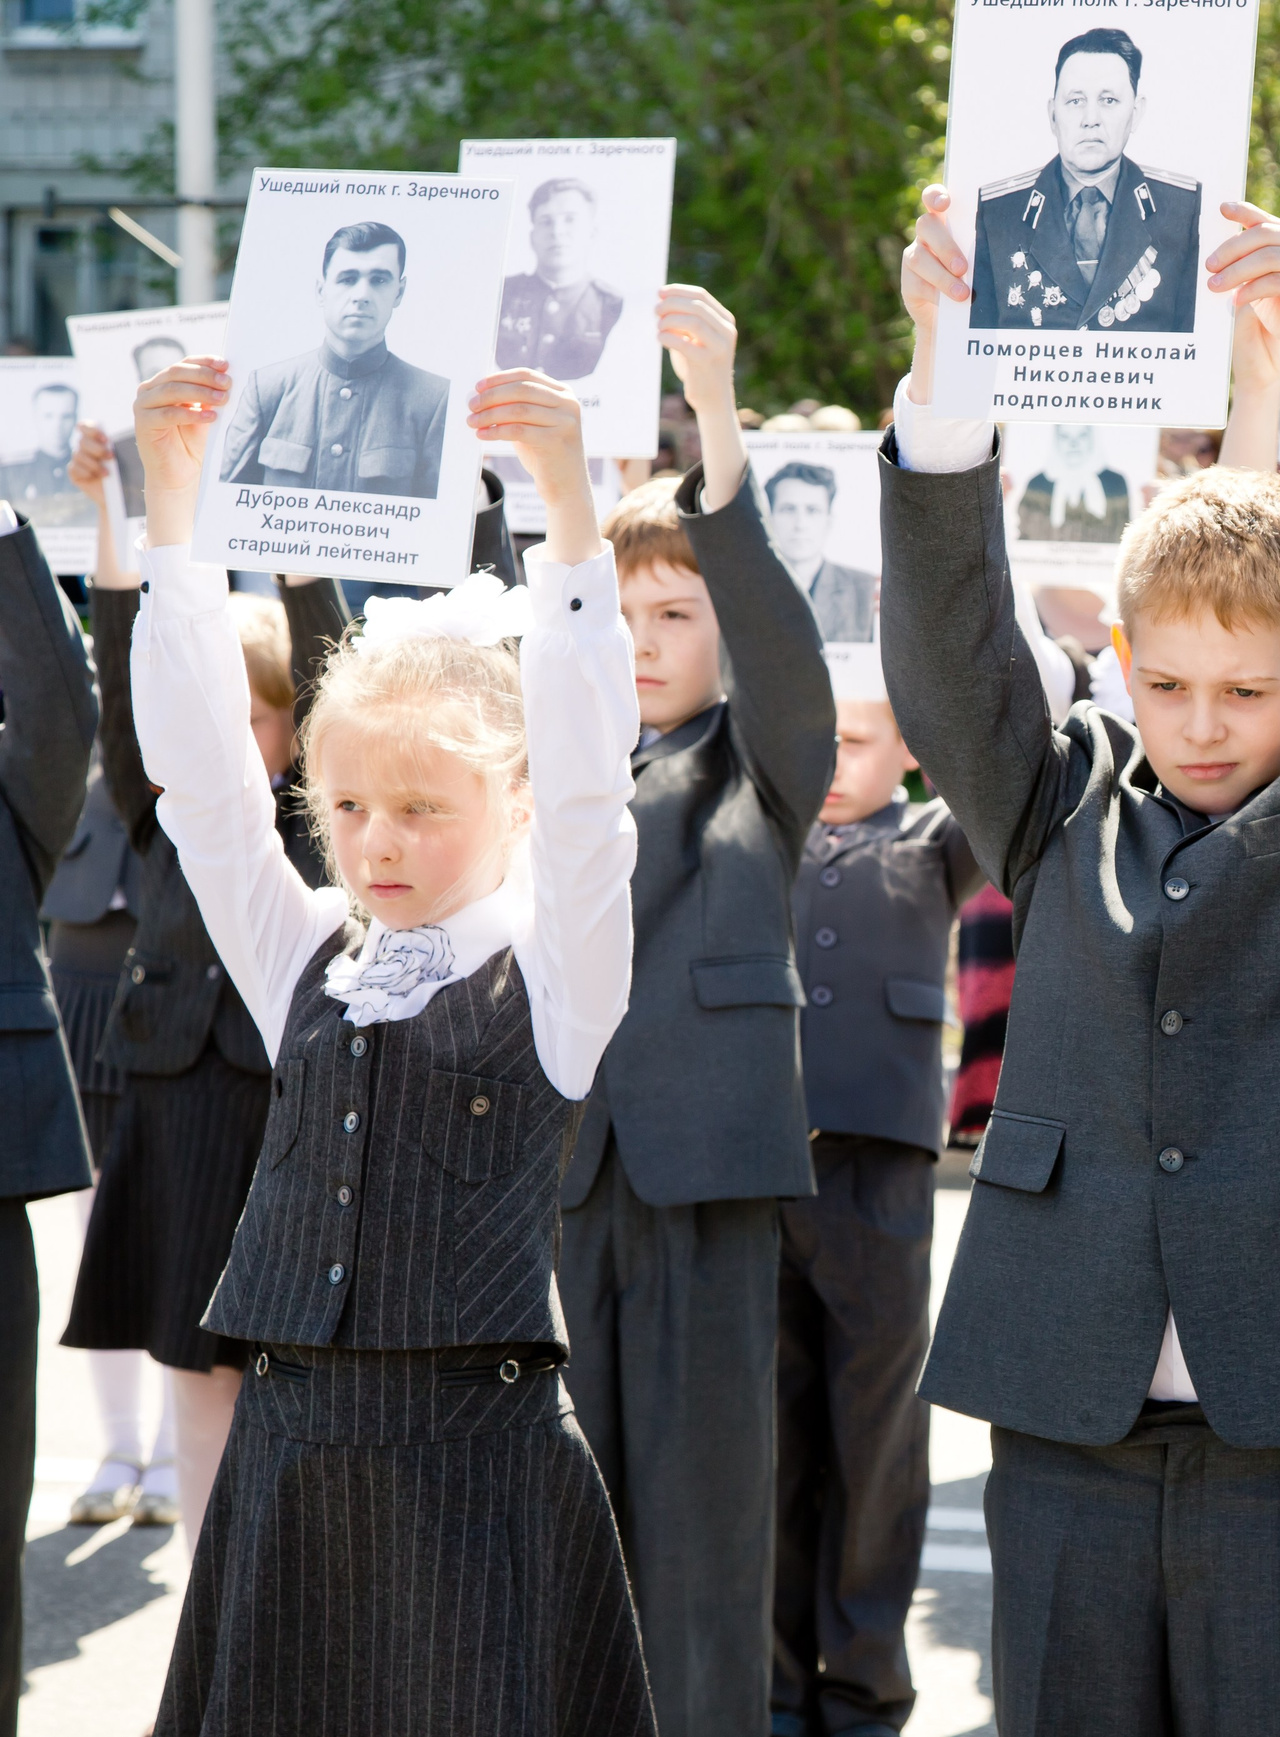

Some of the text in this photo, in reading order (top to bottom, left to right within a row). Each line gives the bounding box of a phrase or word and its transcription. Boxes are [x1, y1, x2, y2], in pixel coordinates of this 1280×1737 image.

[465, 144, 533, 157] Ушедший
[536, 144, 571, 155] полк
[589, 142, 665, 157] Заречного
[259, 178, 500, 201] Ушедший полк г. Заречного
[967, 339, 1197, 361] Поморцев Николай
[1013, 366, 1155, 385] Николаевич
[993, 394, 1162, 410] подполковник
[235, 488, 421, 522] Дубров Александр
[261, 513, 390, 539] Харитонович
[228, 537, 419, 565] старший лейтенант
